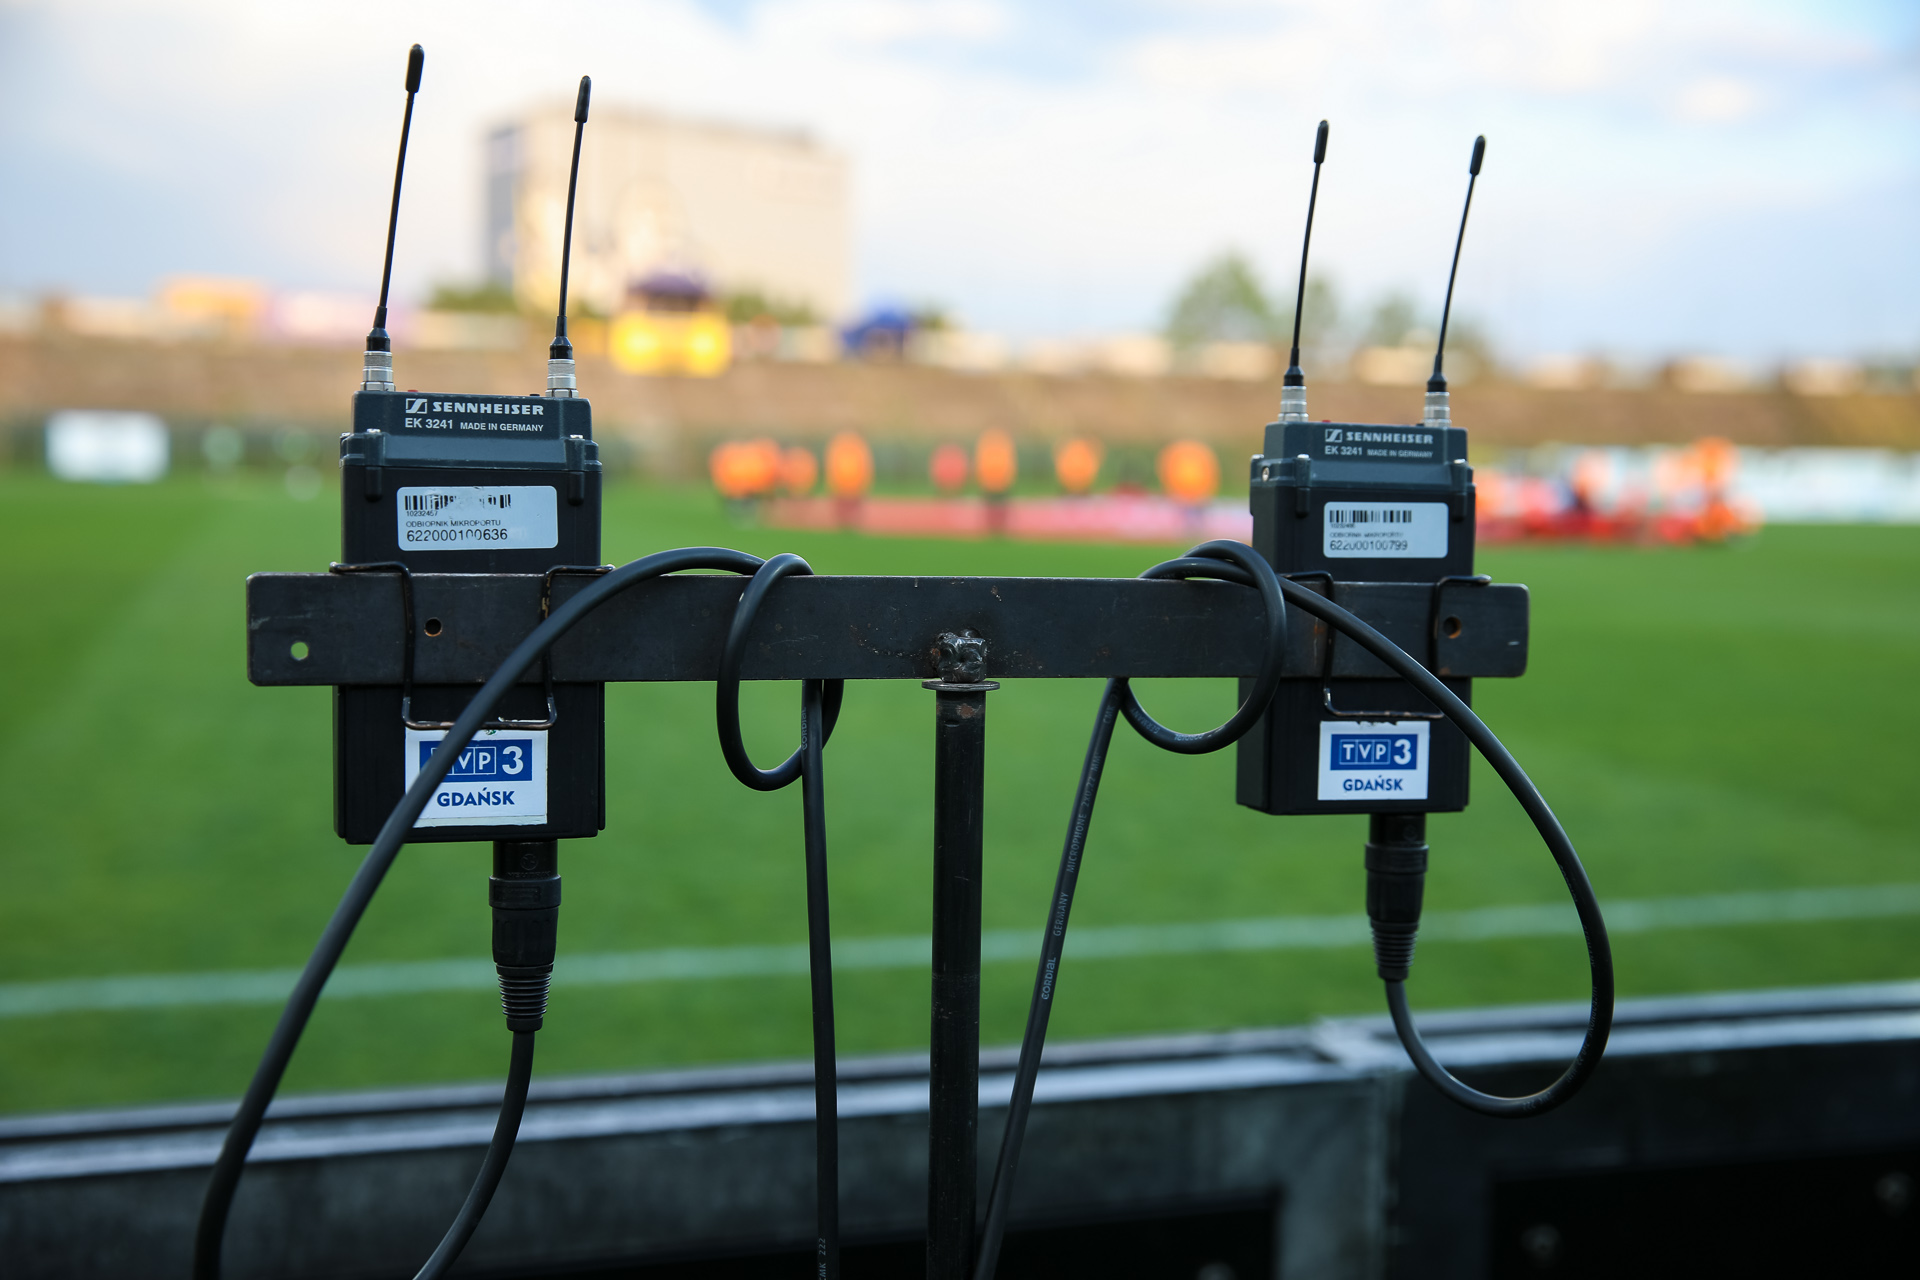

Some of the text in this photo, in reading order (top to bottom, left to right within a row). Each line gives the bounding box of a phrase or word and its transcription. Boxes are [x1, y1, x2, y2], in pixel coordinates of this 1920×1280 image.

[432, 401, 545, 416] SENNHEISER
[404, 417, 544, 432] EK 3241 MADE IN GERMANY
[1346, 431, 1434, 444] SENNHEISER
[1324, 445, 1434, 458] EK 3241 MADE IN GERMANY
[406, 528, 508, 542] 622000100636
[1329, 540, 1408, 551] 622000100799
[452, 752, 491, 771] VP
[1343, 774, 1404, 791] GDAŃSK
[436, 786, 516, 807] GDAŃSK
[1052, 891, 1069, 936] GERMANY
[1066, 813, 1087, 873] MICROPHONE
